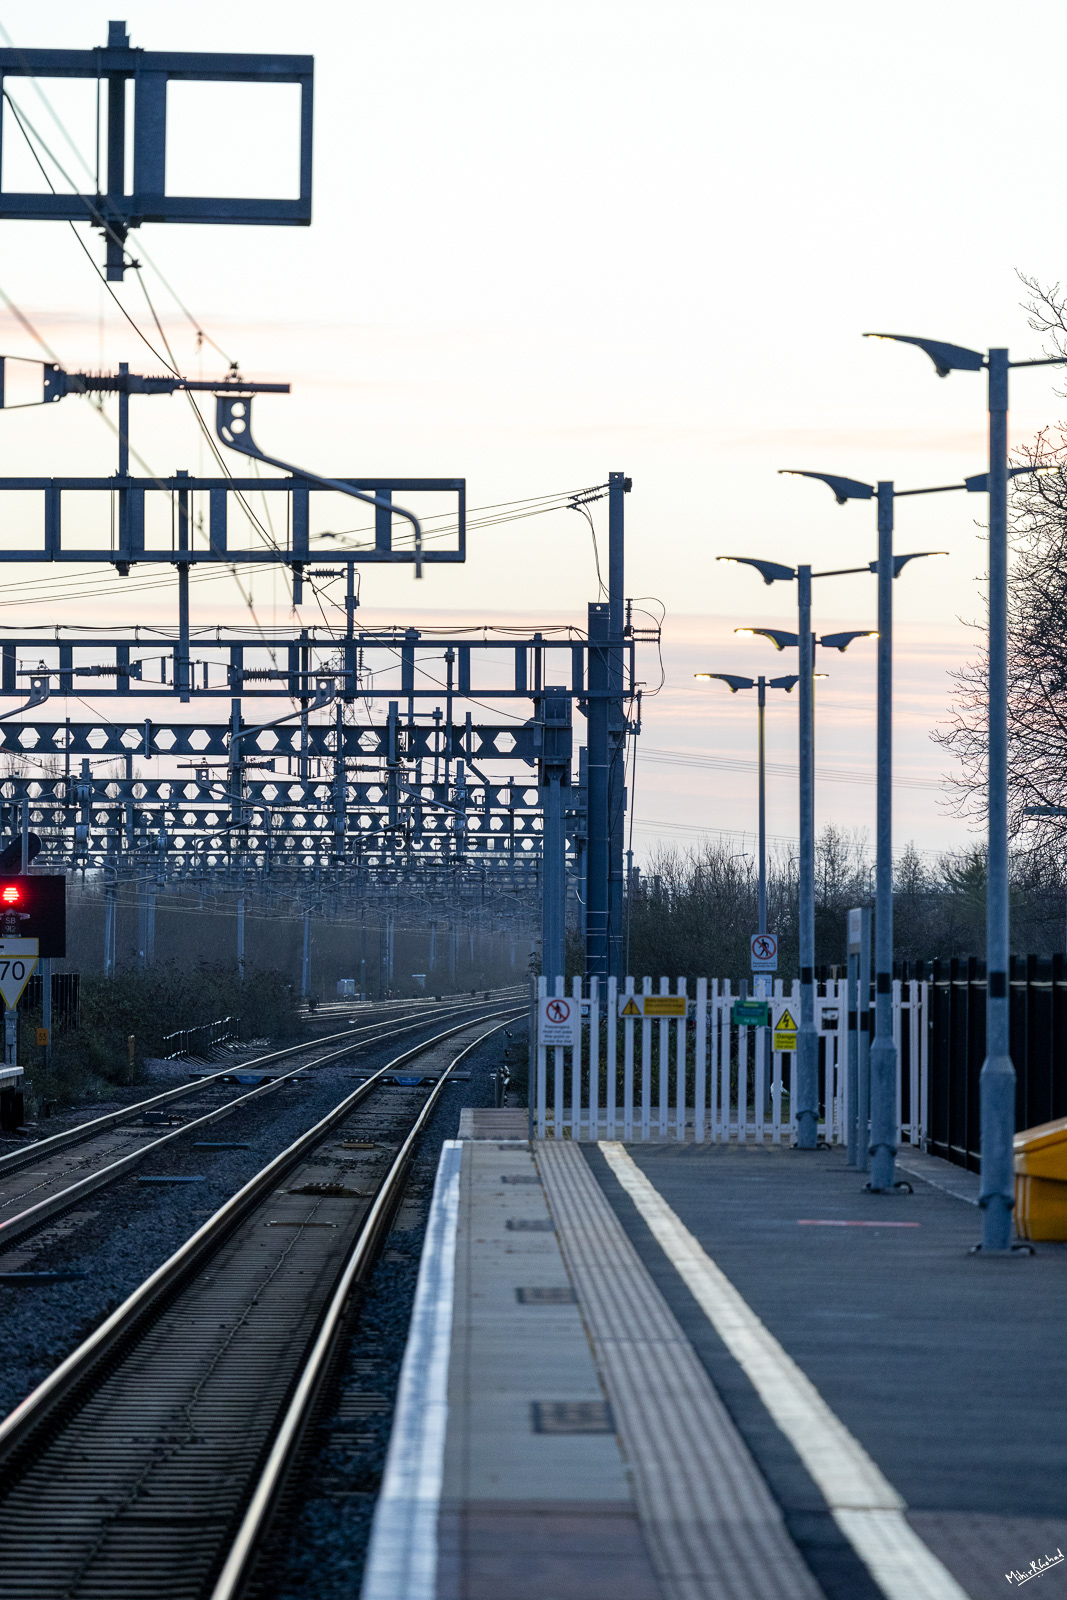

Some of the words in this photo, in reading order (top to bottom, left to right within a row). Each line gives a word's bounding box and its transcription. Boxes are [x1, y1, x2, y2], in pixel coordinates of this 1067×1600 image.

[5, 916, 16, 924] SB
[5, 925, 16, 933] 912
[0, 961, 25, 980] 70
